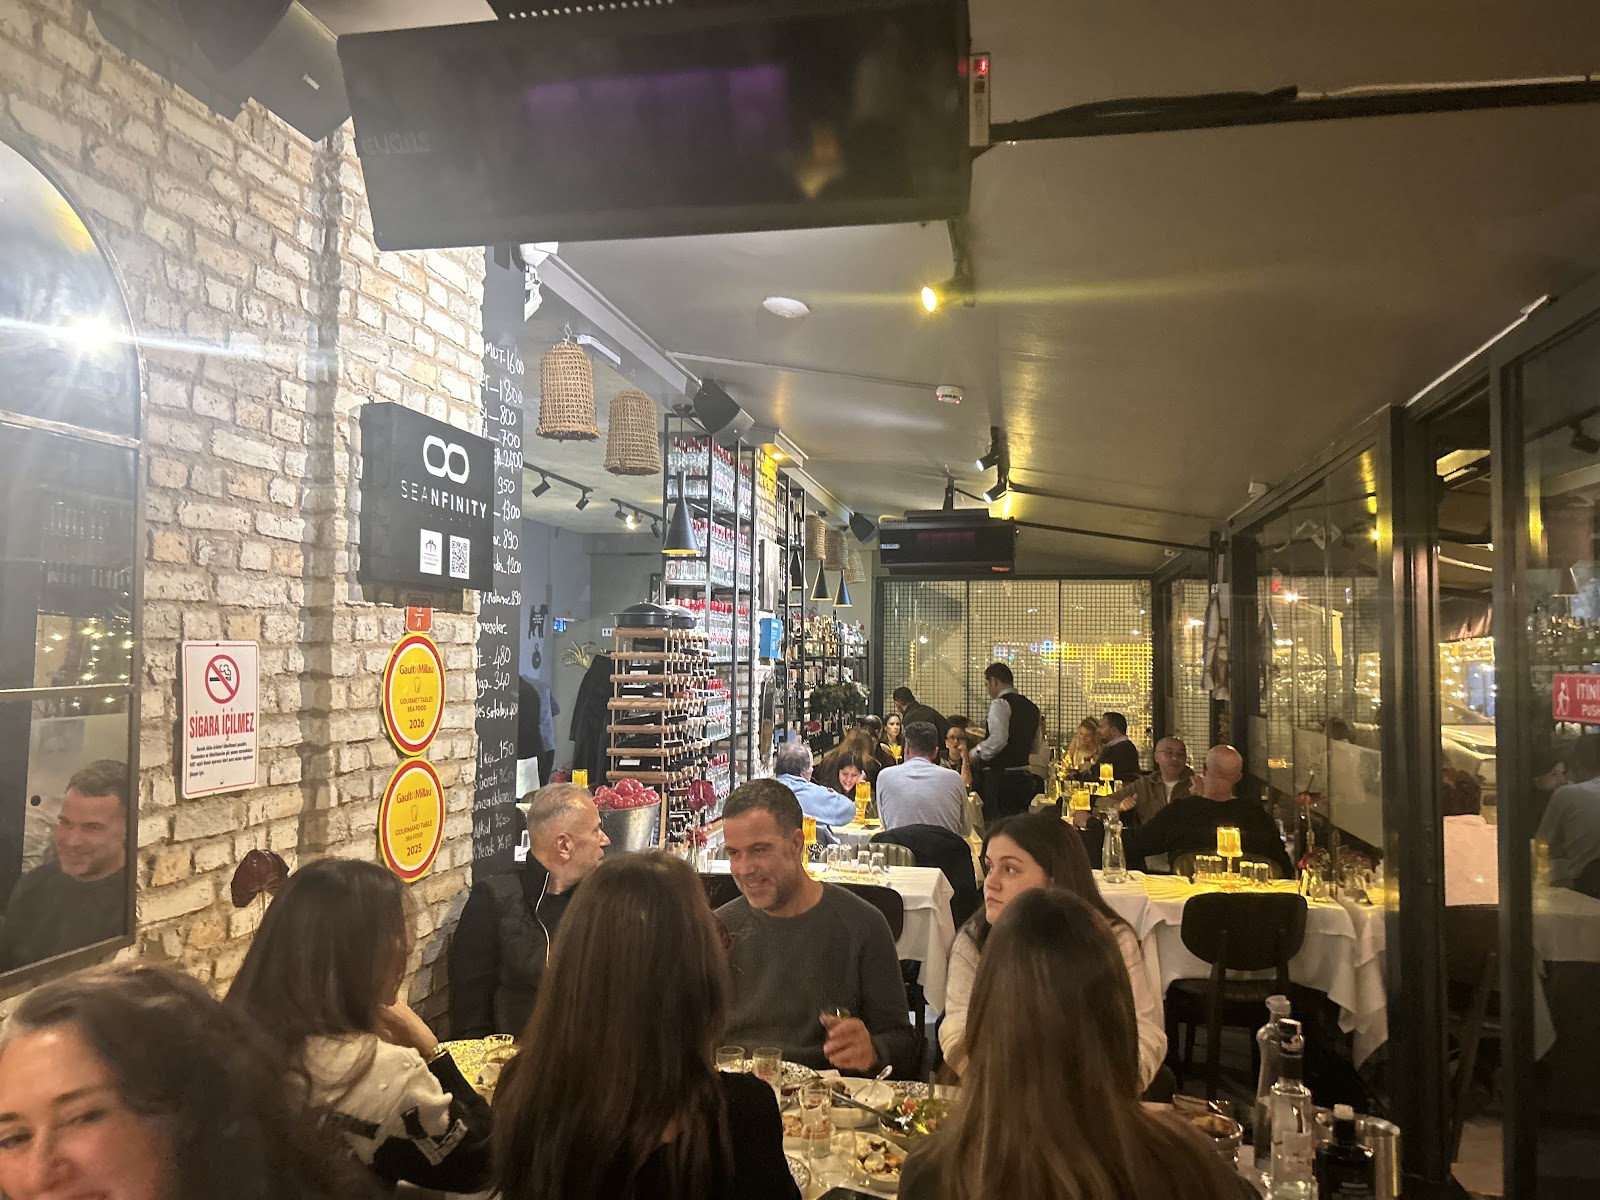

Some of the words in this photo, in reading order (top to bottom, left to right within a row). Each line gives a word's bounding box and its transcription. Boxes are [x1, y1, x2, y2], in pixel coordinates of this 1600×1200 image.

[499, 378, 523, 404] 1800
[500, 405, 516, 426] 800
[500, 429, 520, 449] 700
[497, 476, 515, 494] 950
[401, 480, 487, 519] SEANFINITY
[492, 645, 511, 670] 480
[493, 671, 510, 691] 340
[189, 710, 219, 739] SİGARA
[222, 707, 255, 740] İÇİLMEZ
[409, 718, 425, 729] 2026
[499, 740, 514, 759] 150
[406, 843, 423, 856] 2025
